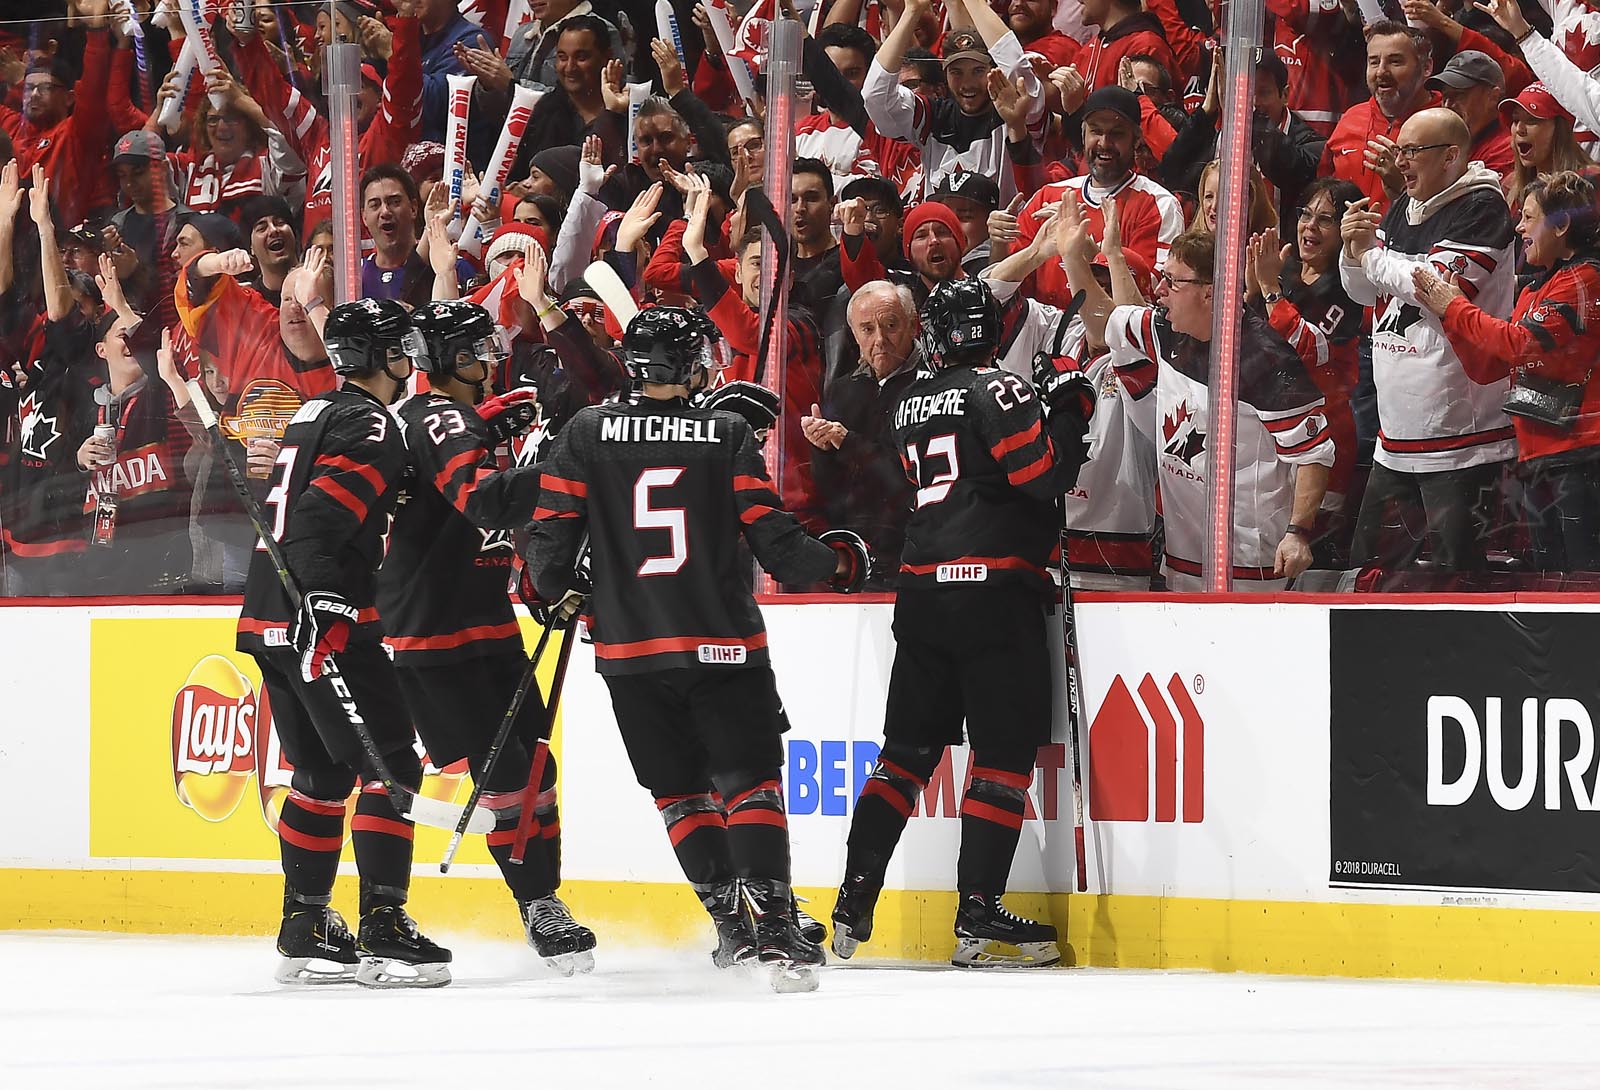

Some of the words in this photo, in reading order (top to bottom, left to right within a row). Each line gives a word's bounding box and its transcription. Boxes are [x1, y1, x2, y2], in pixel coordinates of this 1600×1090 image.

[453, 123, 467, 165] MART
[496, 142, 518, 182] MART
[970, 325, 983, 339] 22
[1319, 304, 1345, 335] 9
[641, 367, 649, 379] 5
[987, 375, 1032, 411] 22
[366, 411, 387, 443] 3
[423, 409, 466, 446] 23
[601, 415, 721, 443] MITCHELL
[255, 445, 300, 552] 3
[633, 465, 688, 577] 5
[949, 570, 983, 579] IIHF
[712, 647, 742, 661] IIHF
[1068, 666, 1078, 714] NEXUS
[177, 690, 255, 777] Lay's
[1342, 860, 1360, 875] 2018
[1361, 861, 1402, 877] DURACELL
